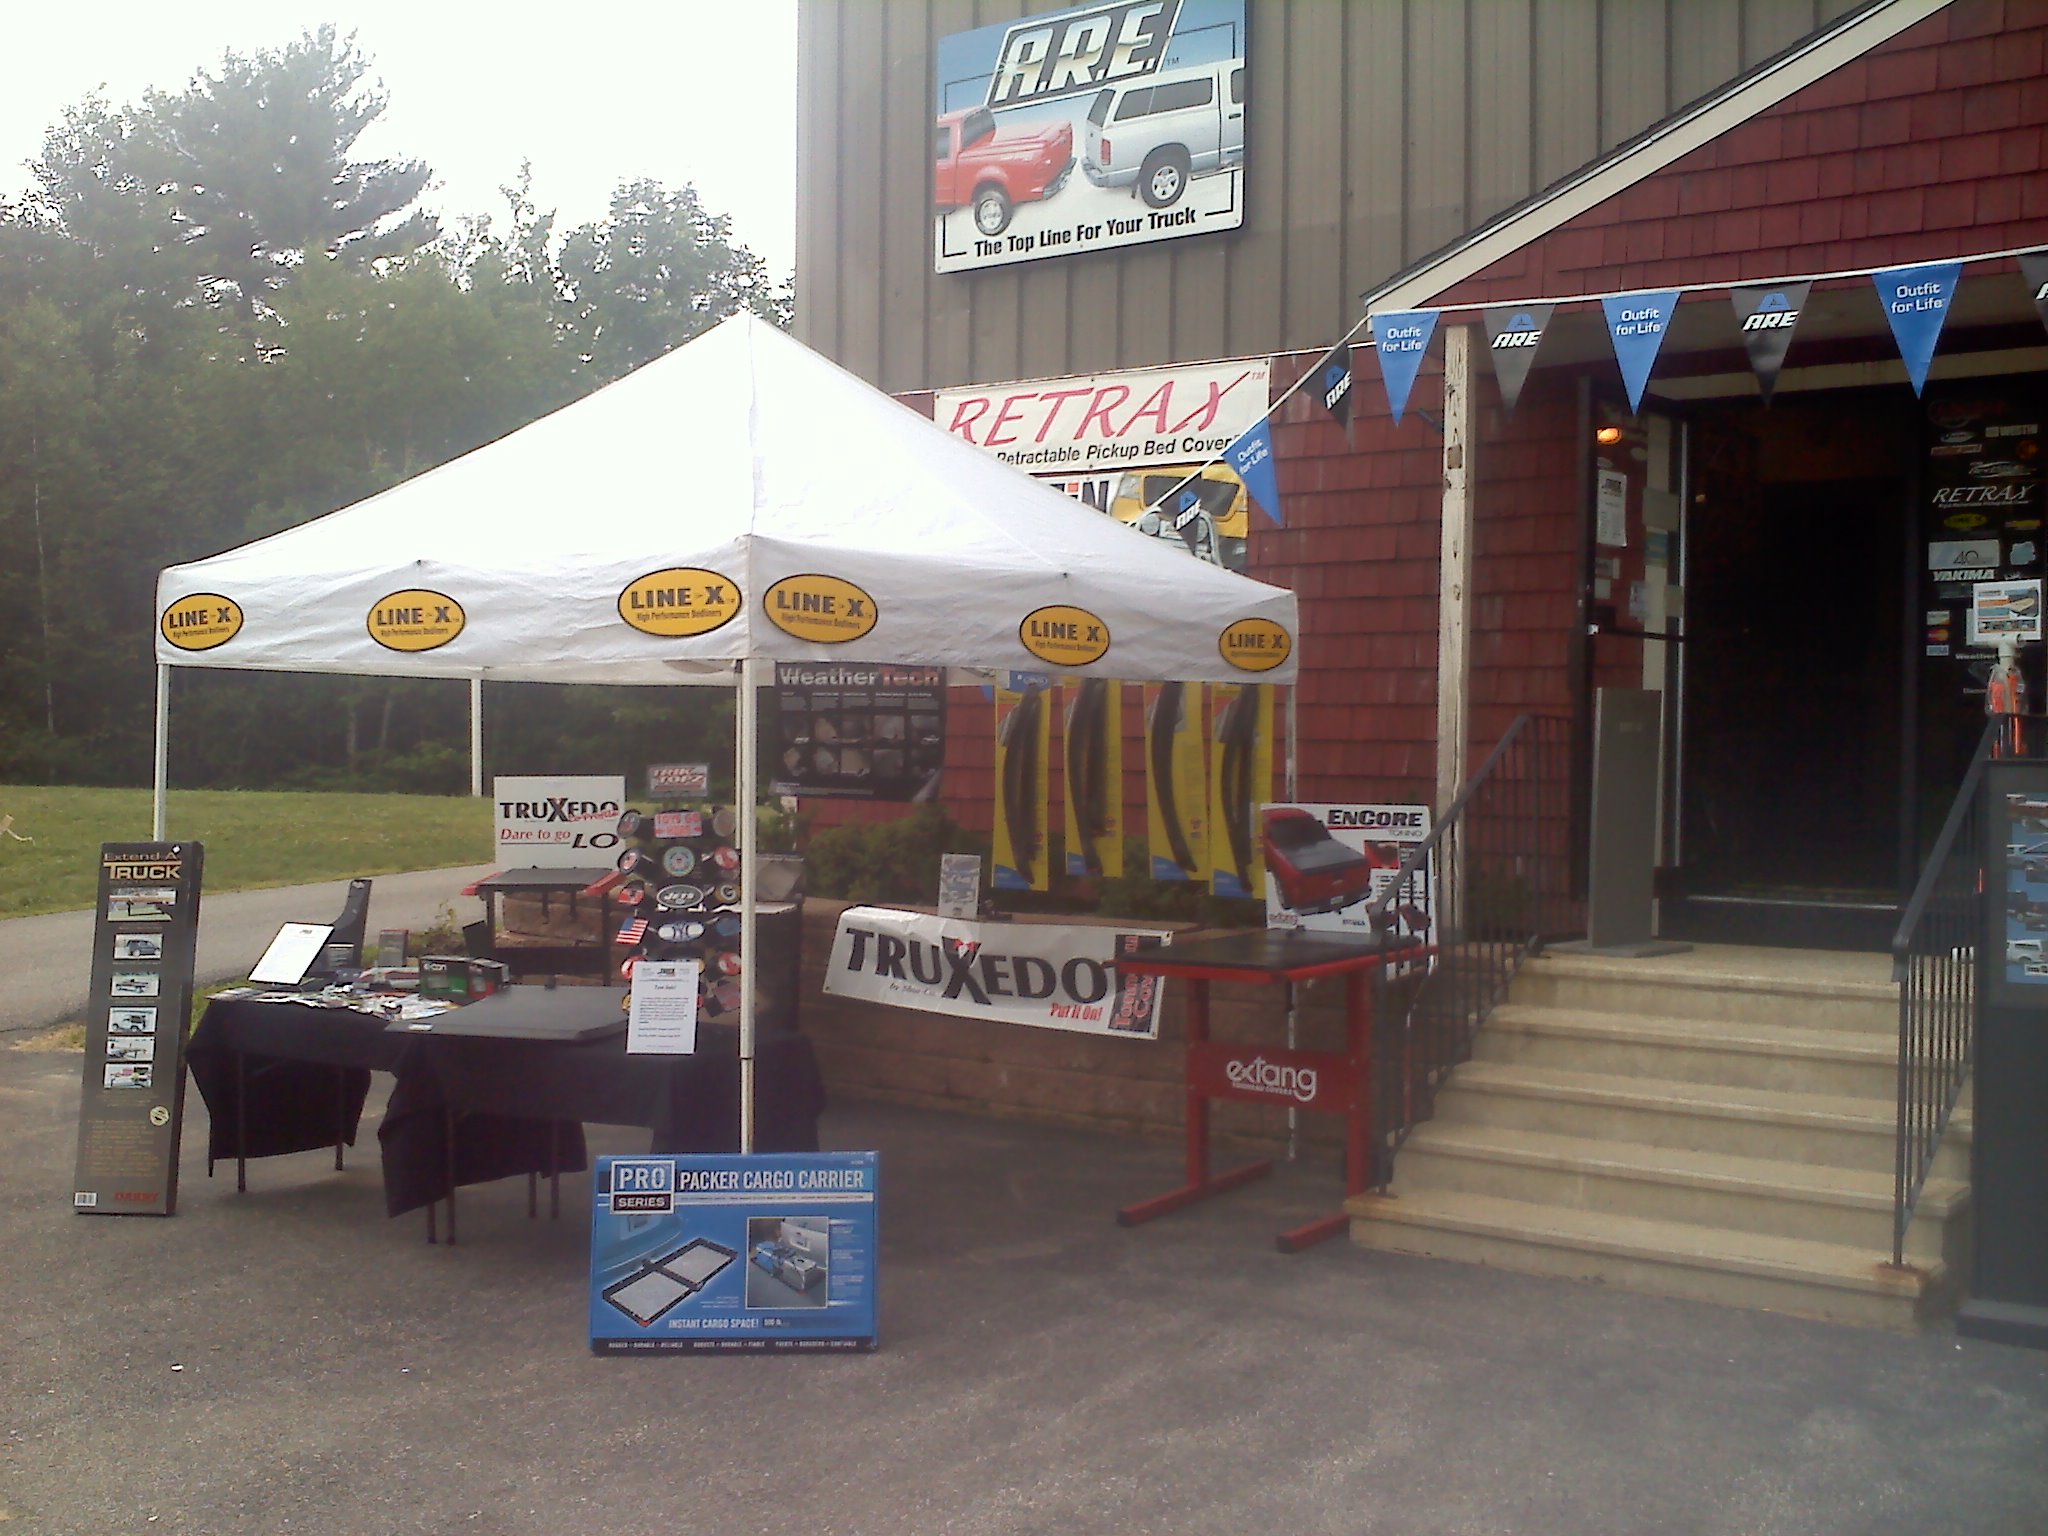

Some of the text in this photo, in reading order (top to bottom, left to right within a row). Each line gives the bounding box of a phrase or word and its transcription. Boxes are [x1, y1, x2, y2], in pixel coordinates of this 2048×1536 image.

[975, 207, 1196, 258] The Top Line For Your Truck
[1897, 282, 1940, 298] Outfit
[1892, 297, 1943, 314] for Life
[1622, 309, 1659, 322] Outfit
[1742, 310, 1798, 331] ARE
[1387, 327, 1421, 340] Outfit
[1616, 321, 1661, 336] for Life
[1382, 340, 1422, 353] for Life
[1492, 330, 1541, 349] ARE
[1326, 371, 1351, 410] ARE
[949, 371, 1251, 447] RETRAX
[1086, 442, 1139, 461] Pickup
[1144, 438, 1176, 456] Bed
[1237, 437, 1263, 461] Outfit
[1238, 448, 1269, 475] for Life
[1932, 484, 2036, 503] RETRAX
[1933, 570, 1995, 581] YAKIMA
[500, 798, 619, 822] TRUXEDO
[1328, 810, 1422, 827] ENCORE
[500, 828, 619, 848] Dare to go LO
[104, 852, 178, 861] Extend A
[103, 861, 182, 879] TRUCK
[846, 928, 1108, 1005] TRUXEDO
[1227, 1056, 1316, 1101] extang
[618, 1167, 665, 1189] PRO
[680, 1169, 864, 1190] PACKER CARGO CARRIER
[618, 1197, 665, 1208] SERIES
[669, 1318, 701, 1329] INSTANT
[702, 1318, 729, 1328] CARGO
[730, 1318, 759, 1328] SPACE!
